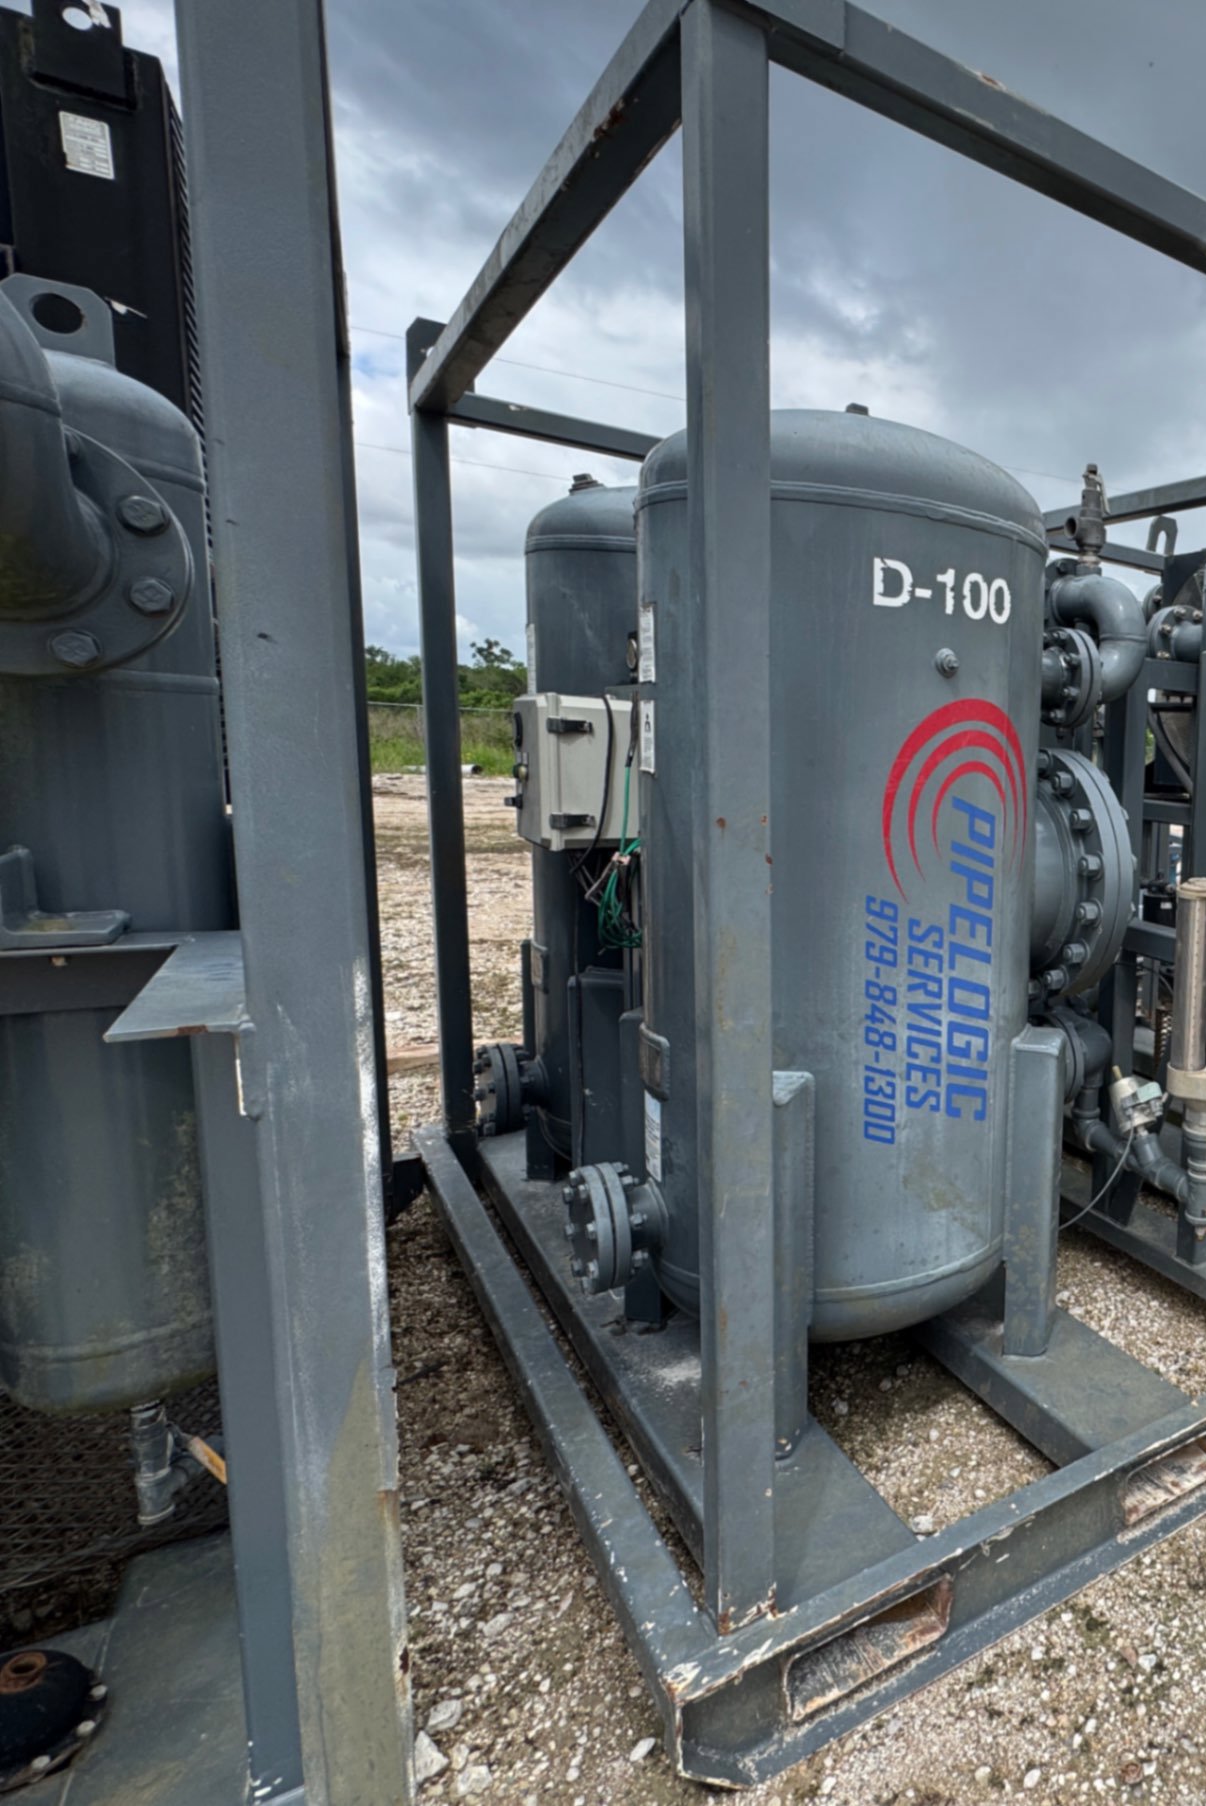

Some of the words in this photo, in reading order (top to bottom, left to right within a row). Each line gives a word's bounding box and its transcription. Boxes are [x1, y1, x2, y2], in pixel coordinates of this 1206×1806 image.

[873, 558, 1011, 624] D-100
[864, 895, 899, 1145] 979-848-1300
[906, 918, 945, 1112] SERVICES
[946, 797, 995, 1121] PIPELOGIC
